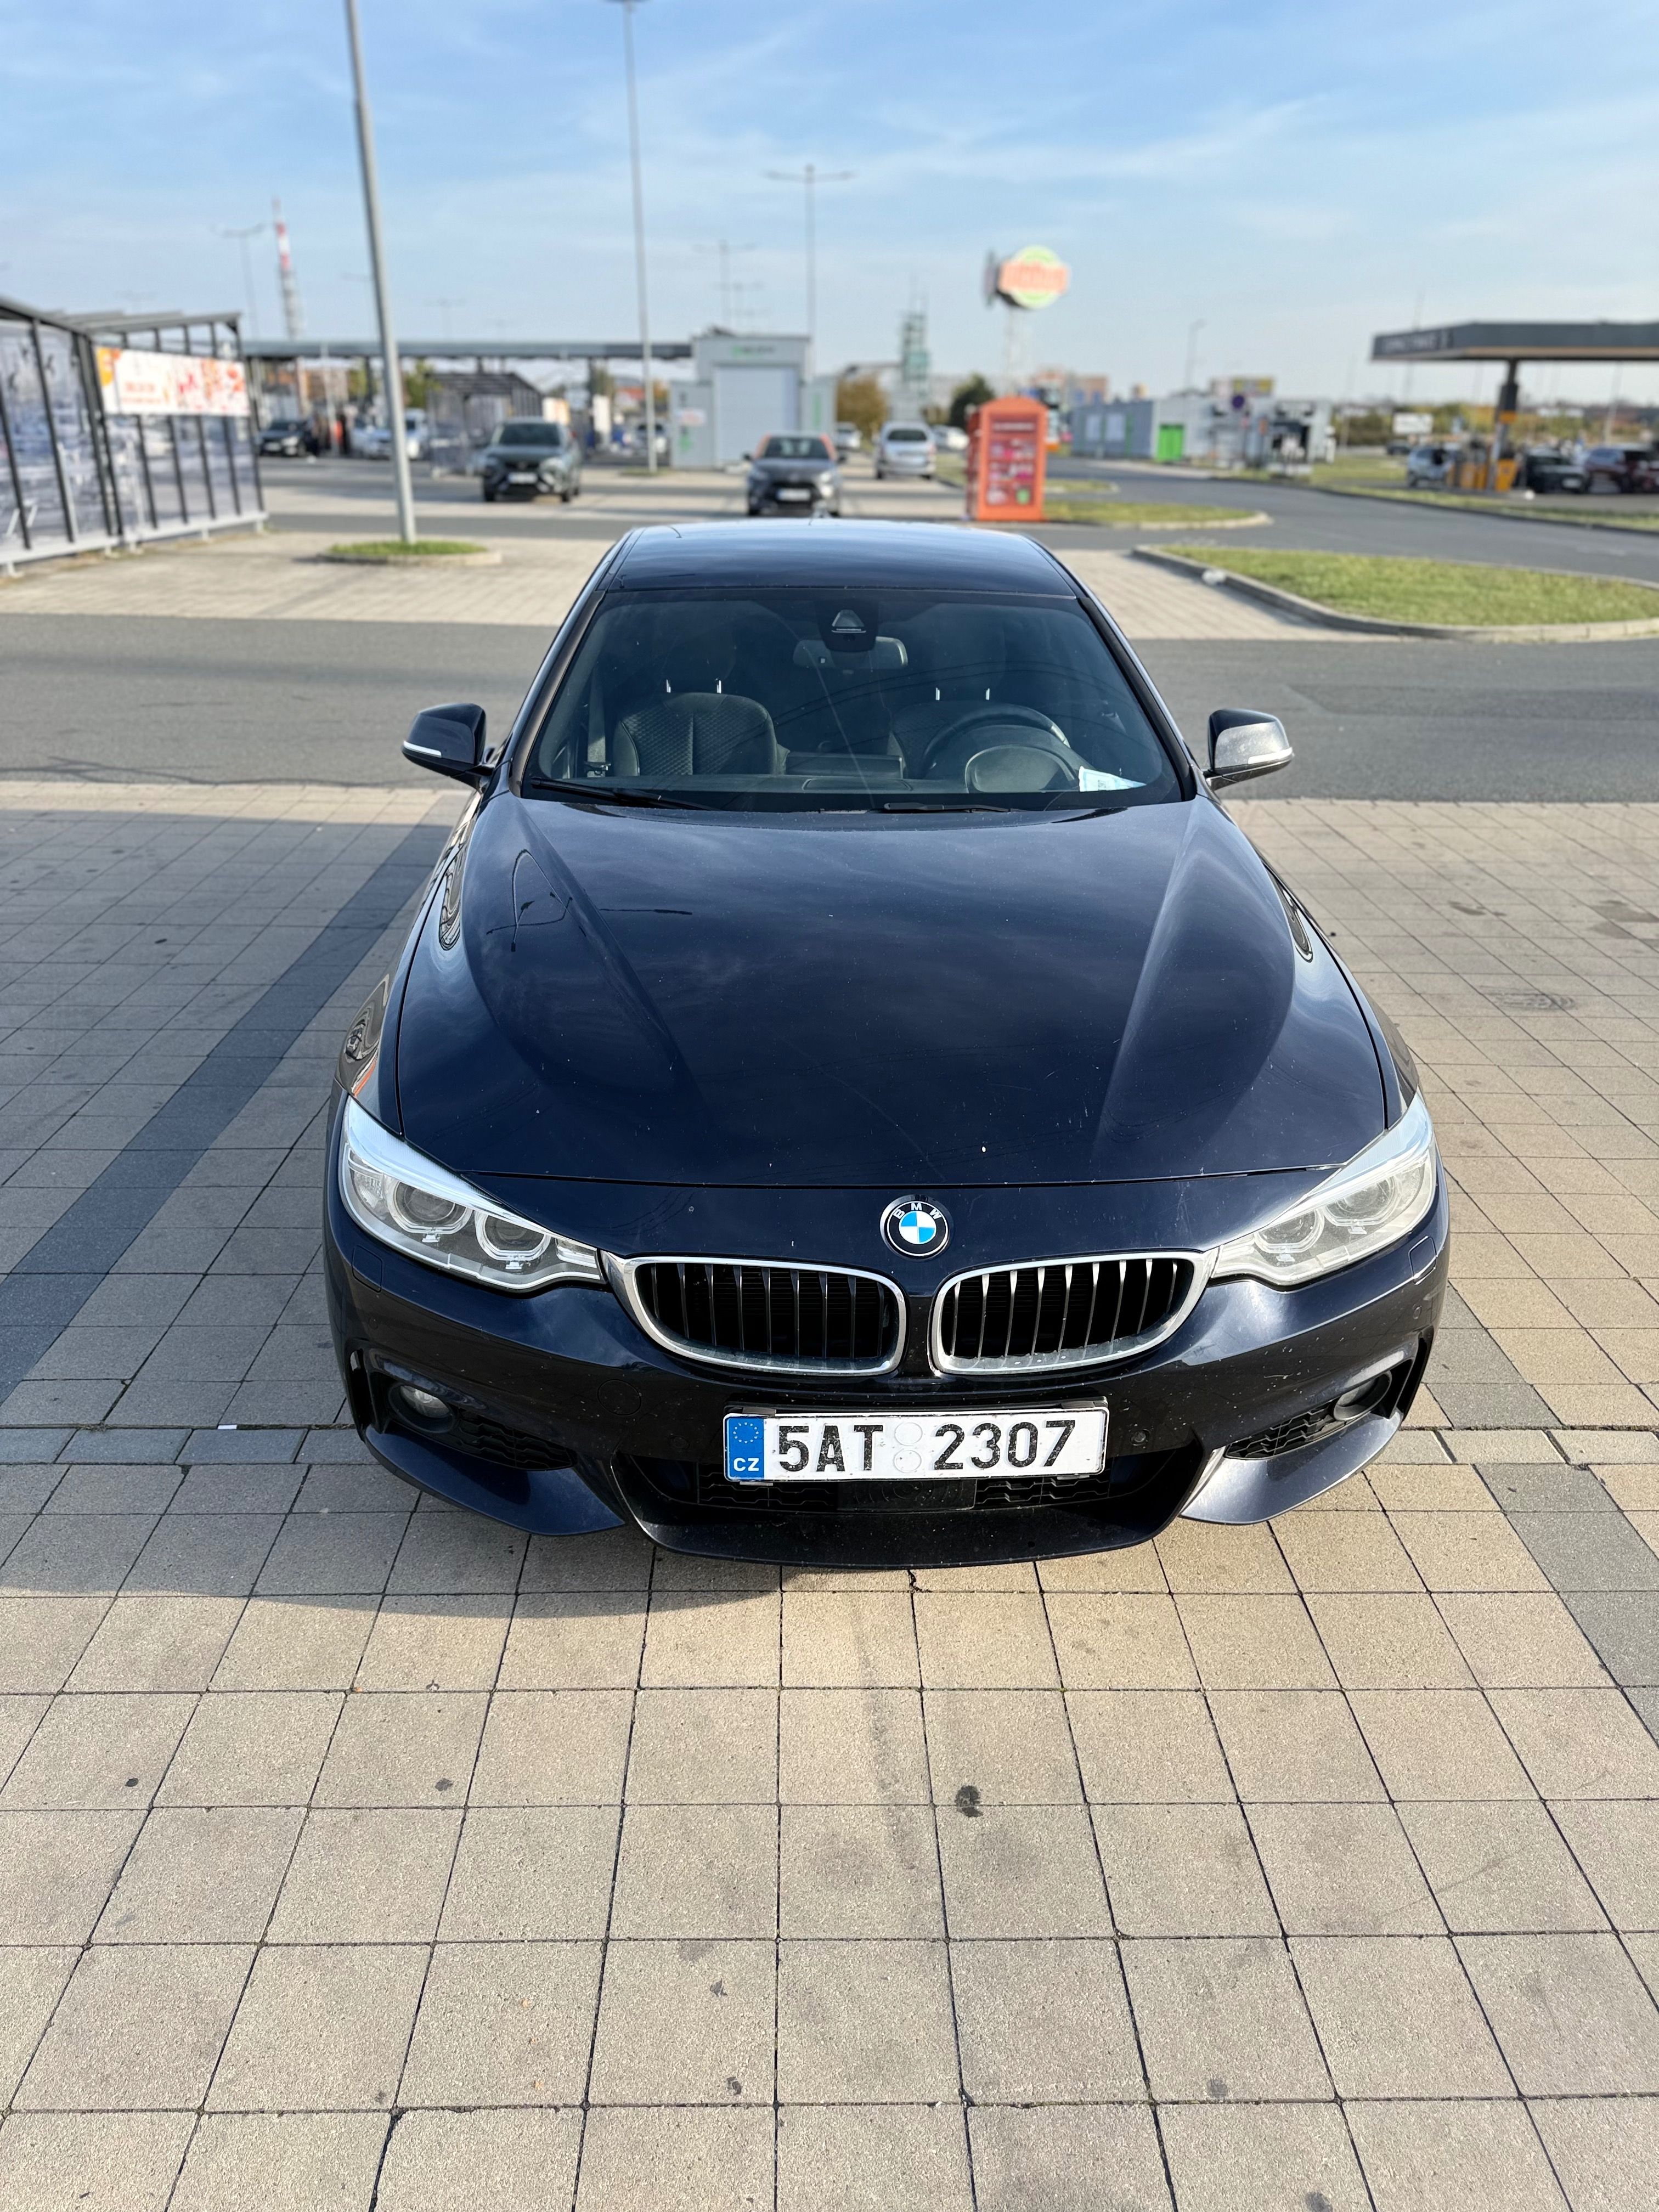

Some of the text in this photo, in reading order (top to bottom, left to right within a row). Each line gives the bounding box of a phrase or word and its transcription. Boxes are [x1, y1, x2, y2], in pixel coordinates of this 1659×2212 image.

[893, 1203, 943, 1220] BMW
[779, 1420, 1075, 1471] 5AT 2307
[733, 1457, 760, 1471] CZ
